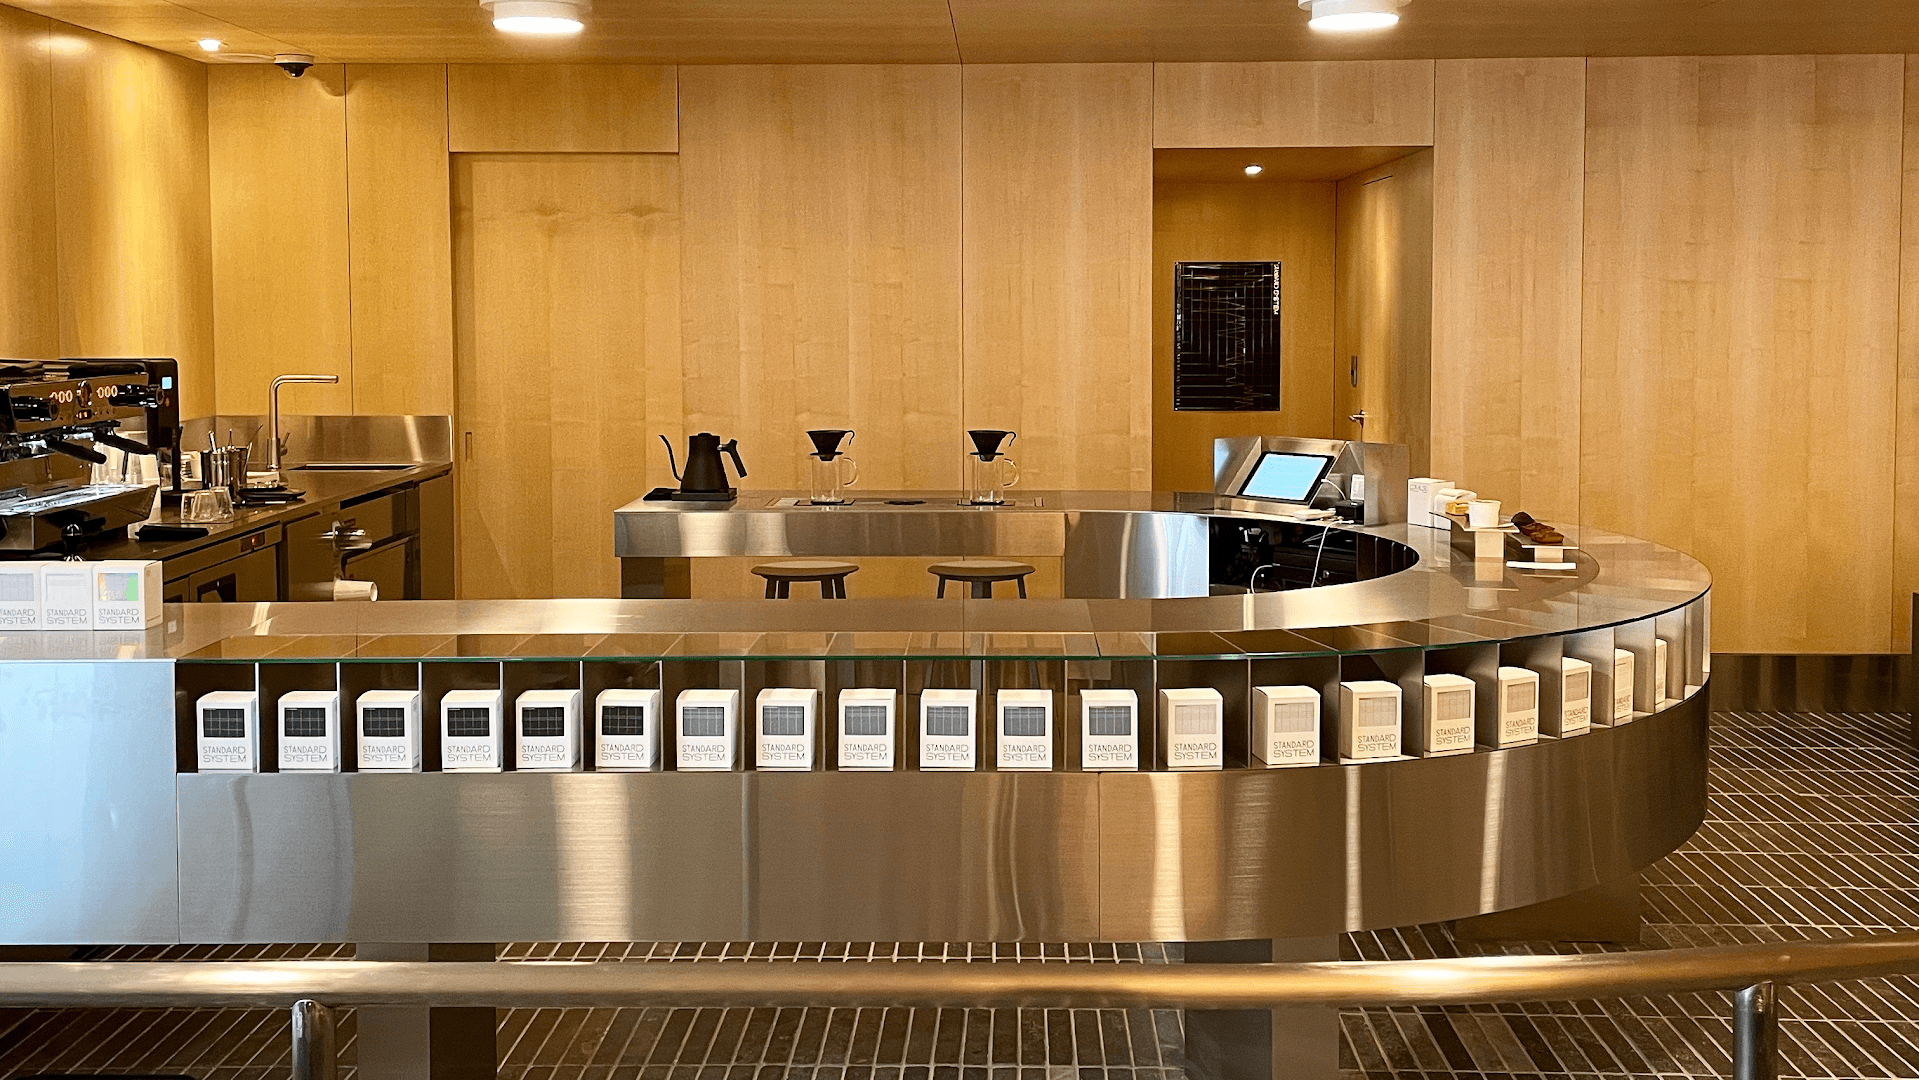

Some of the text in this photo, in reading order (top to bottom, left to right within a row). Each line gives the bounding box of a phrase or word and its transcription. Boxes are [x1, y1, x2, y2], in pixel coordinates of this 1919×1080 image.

[1564, 706, 1588, 718] STANDARD
[1505, 717, 1535, 729] STANDARD
[1564, 715, 1588, 726] SYSTEM
[1436, 726, 1470, 737] STANDARD
[1505, 726, 1535, 736] SYSTEM
[1358, 734, 1396, 743] STANDARD
[1436, 735, 1471, 745] SYSTEM
[447, 745, 490, 753] STANDARD
[522, 745, 565, 753] STANDARD
[601, 744, 644, 752] STANDARD
[762, 744, 804, 752] STANDARD
[844, 744, 887, 752] STANDARD
[926, 744, 969, 752] STANDARD
[1003, 744, 1046, 752] STANDARD
[1089, 744, 1132, 752] STANDARD
[1174, 743, 1217, 751] STANDARD
[1274, 741, 1314, 749] STANDARD
[1358, 742, 1397, 751] SYSTEM
[203, 746, 246, 754] STANDARD
[284, 745, 327, 754] STANDARD
[1274, 749, 1314, 757] SYSTEM
[284, 754, 327, 762] SYSTEM
[363, 754, 406, 762] SYSTEM
[447, 754, 491, 762] SYSTEM
[522, 753, 565, 762] SYSTEM
[601, 752, 644, 760] SYSTEM
[682, 753, 725, 761] SYSTEM
[762, 752, 805, 760] SYSTEM
[844, 752, 887, 760] SYSTEM
[926, 752, 969, 760] SYSTEM
[1003, 753, 1046, 761] SYSTEM
[1088, 753, 1132, 761] SYSTEM
[1174, 751, 1217, 760] SYSTEM
